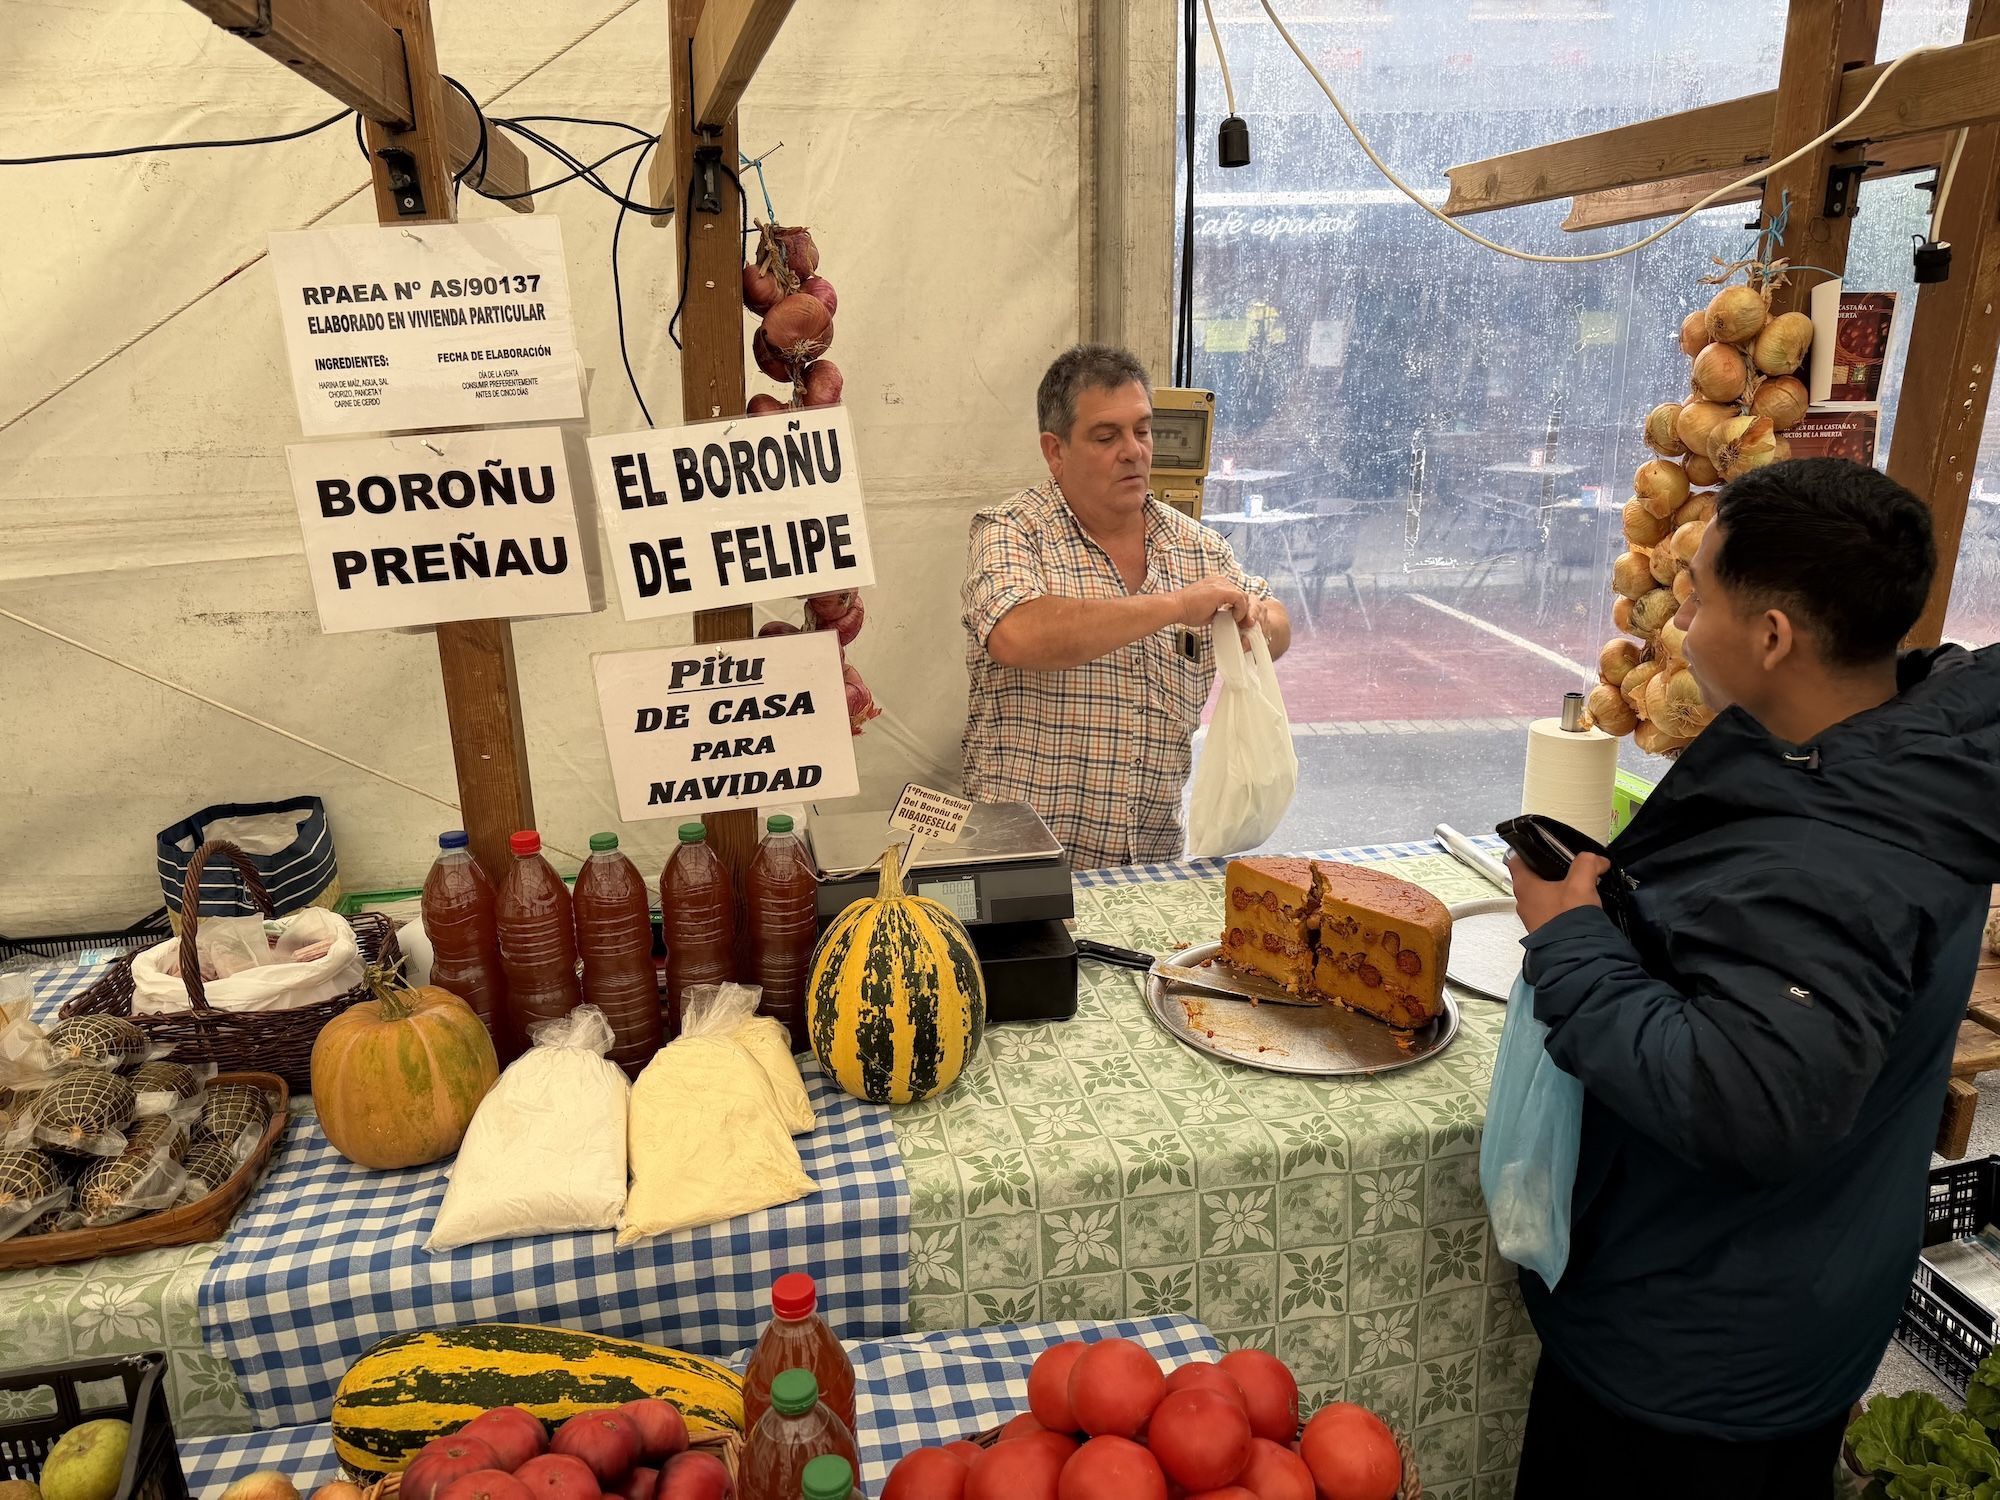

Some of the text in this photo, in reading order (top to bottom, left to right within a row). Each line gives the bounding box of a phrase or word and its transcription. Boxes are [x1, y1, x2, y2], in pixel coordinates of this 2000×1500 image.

[302, 275, 541, 305] RPAEA Nº AS/90137
[308, 303, 546, 335] ELABORADO EN VIVIENDA PARTICULAR
[315, 355, 390, 371] INGREDIENTES:
[437, 345, 552, 363] FECHA DE ELABORACIÓN
[319, 381, 338, 390] HARINA
[339, 380, 347, 388] DE
[462, 378, 538, 390] CONSUMIR PREFERENTEMENTE
[478, 370, 487, 379] DÍA
[503, 369, 519, 378] VENTA
[334, 398, 381, 408] CARNE DE CERDO
[355, 388, 377, 397] PANCETA
[475, 391, 492, 399] ANTES
[501, 389, 516, 397] CINCO
[517, 387, 529, 397] DÍAS
[1824, 423, 1851, 431] CASTAÑA
[611, 420, 842, 510] EL BOROÑU
[316, 459, 556, 518] BOROÑU
[332, 532, 568, 590] PREÑAU
[629, 514, 857, 598] DE FELIPE
[668, 653, 765, 691] Pitu
[635, 690, 815, 733] DE CASA
[691, 735, 776, 762] PARA
[648, 765, 823, 806] NAVIDAD
[903, 797, 964, 821] Del Boroñu de
[942, 797, 971, 812] festival
[898, 808, 957, 832] RIBADESELLA
